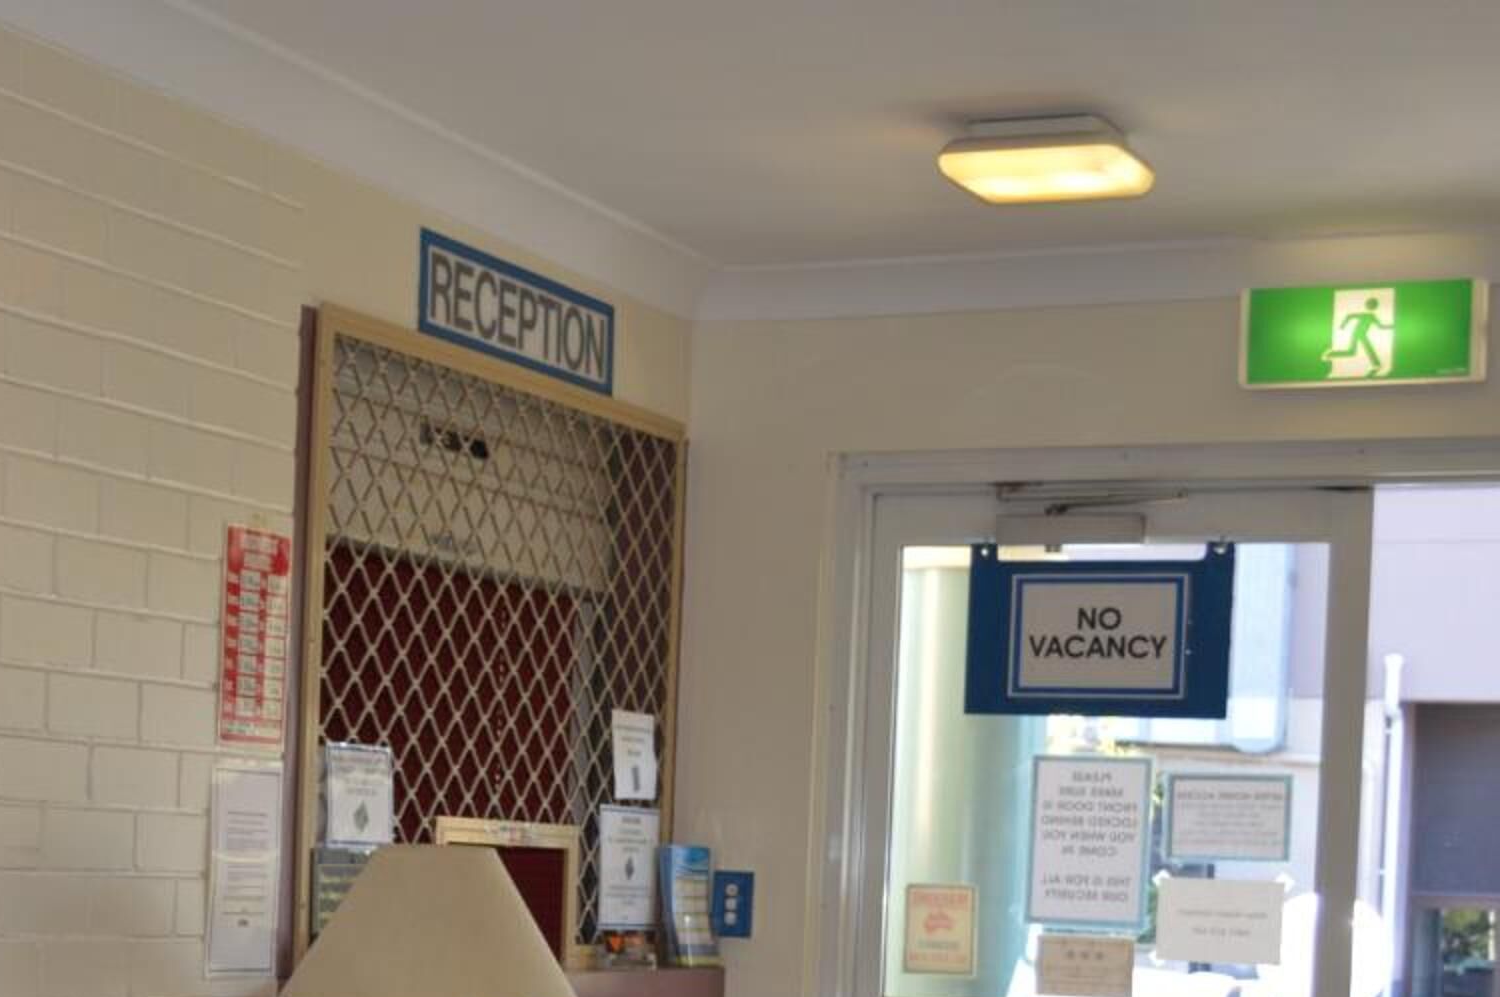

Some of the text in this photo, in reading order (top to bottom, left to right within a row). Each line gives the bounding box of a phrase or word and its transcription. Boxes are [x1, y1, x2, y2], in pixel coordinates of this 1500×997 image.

[430, 250, 605, 379] RECEPTION
[1077, 606, 1123, 631] NO
[1028, 634, 1168, 660] VACANCY
